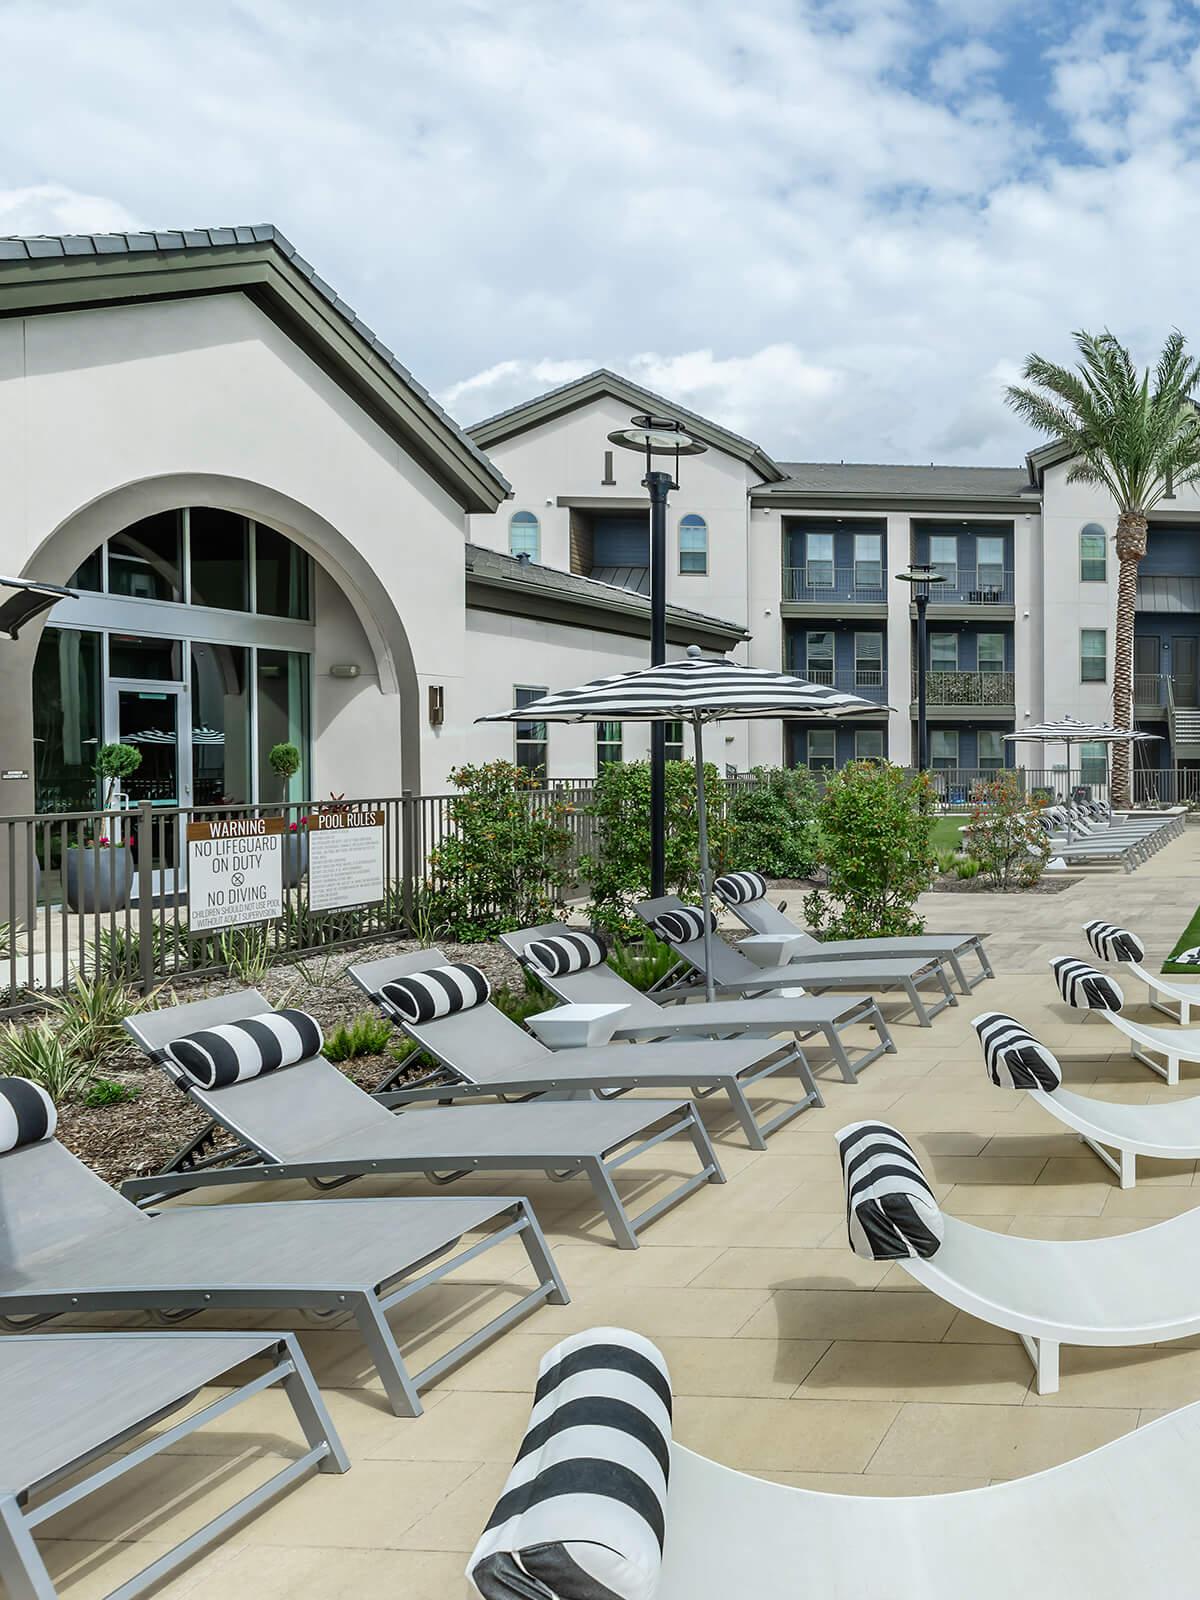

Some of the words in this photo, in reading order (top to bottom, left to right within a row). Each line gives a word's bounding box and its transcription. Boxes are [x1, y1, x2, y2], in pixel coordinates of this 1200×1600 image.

[209, 819, 266, 838] WARNING
[319, 814, 344, 829] POOL
[347, 812, 376, 827] RULES
[194, 841, 212, 857] NO
[216, 836, 277, 856] LIFEGUARD
[212, 857, 228, 873] ON
[232, 854, 262, 871] DUTY
[208, 891, 224, 907] NO
[229, 885, 267, 904] DIVING
[192, 908, 221, 919] CHILDREN
[221, 904, 243, 914] SHOULD
[244, 902, 255, 911] NOT
[256, 901, 266, 909] USE
[267, 899, 280, 908] POOL
[197, 917, 223, 928] WITHOUT
[224, 914, 241, 923] ADULT
